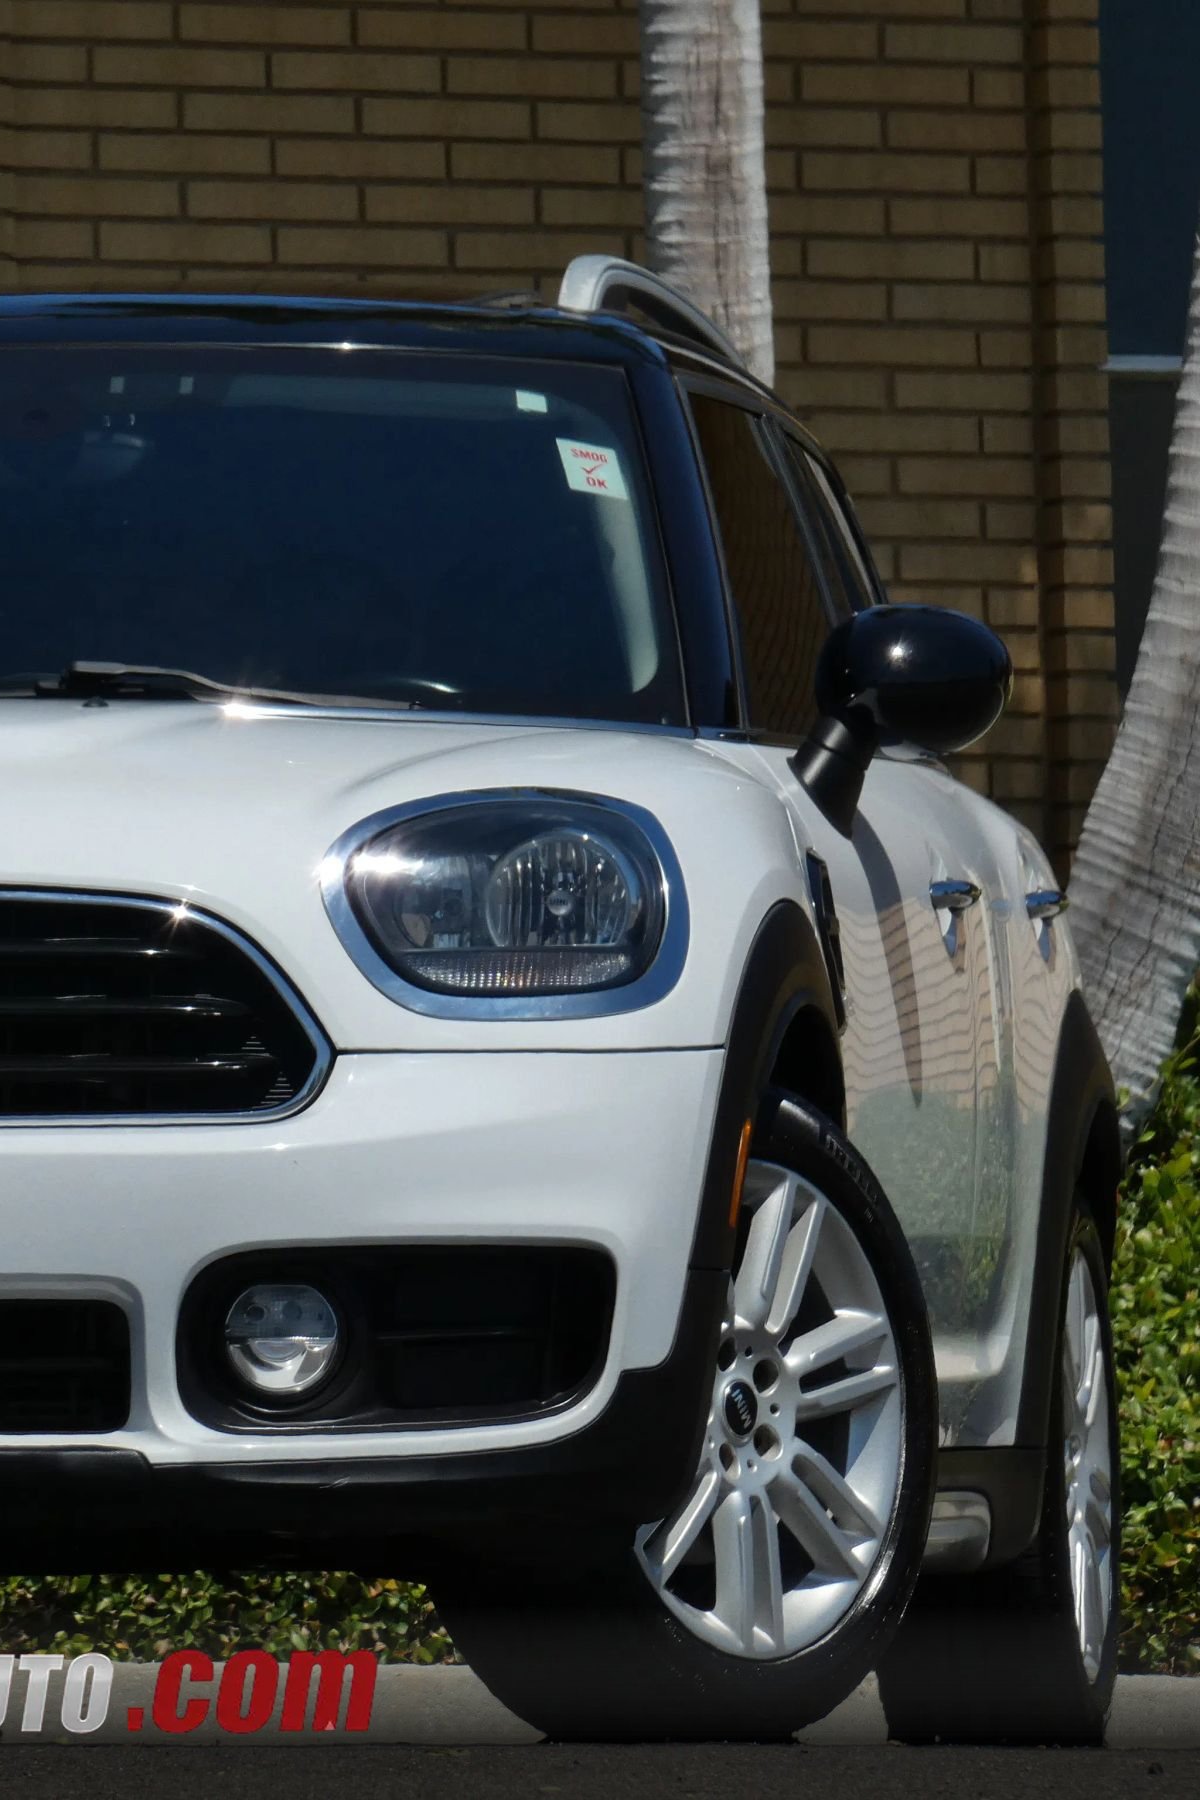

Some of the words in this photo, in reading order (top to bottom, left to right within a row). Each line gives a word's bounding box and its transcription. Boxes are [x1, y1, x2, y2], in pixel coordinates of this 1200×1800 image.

[571, 449, 608, 463] SMOG
[586, 477, 607, 489] OK
[732, 1389, 751, 1428] MINI
